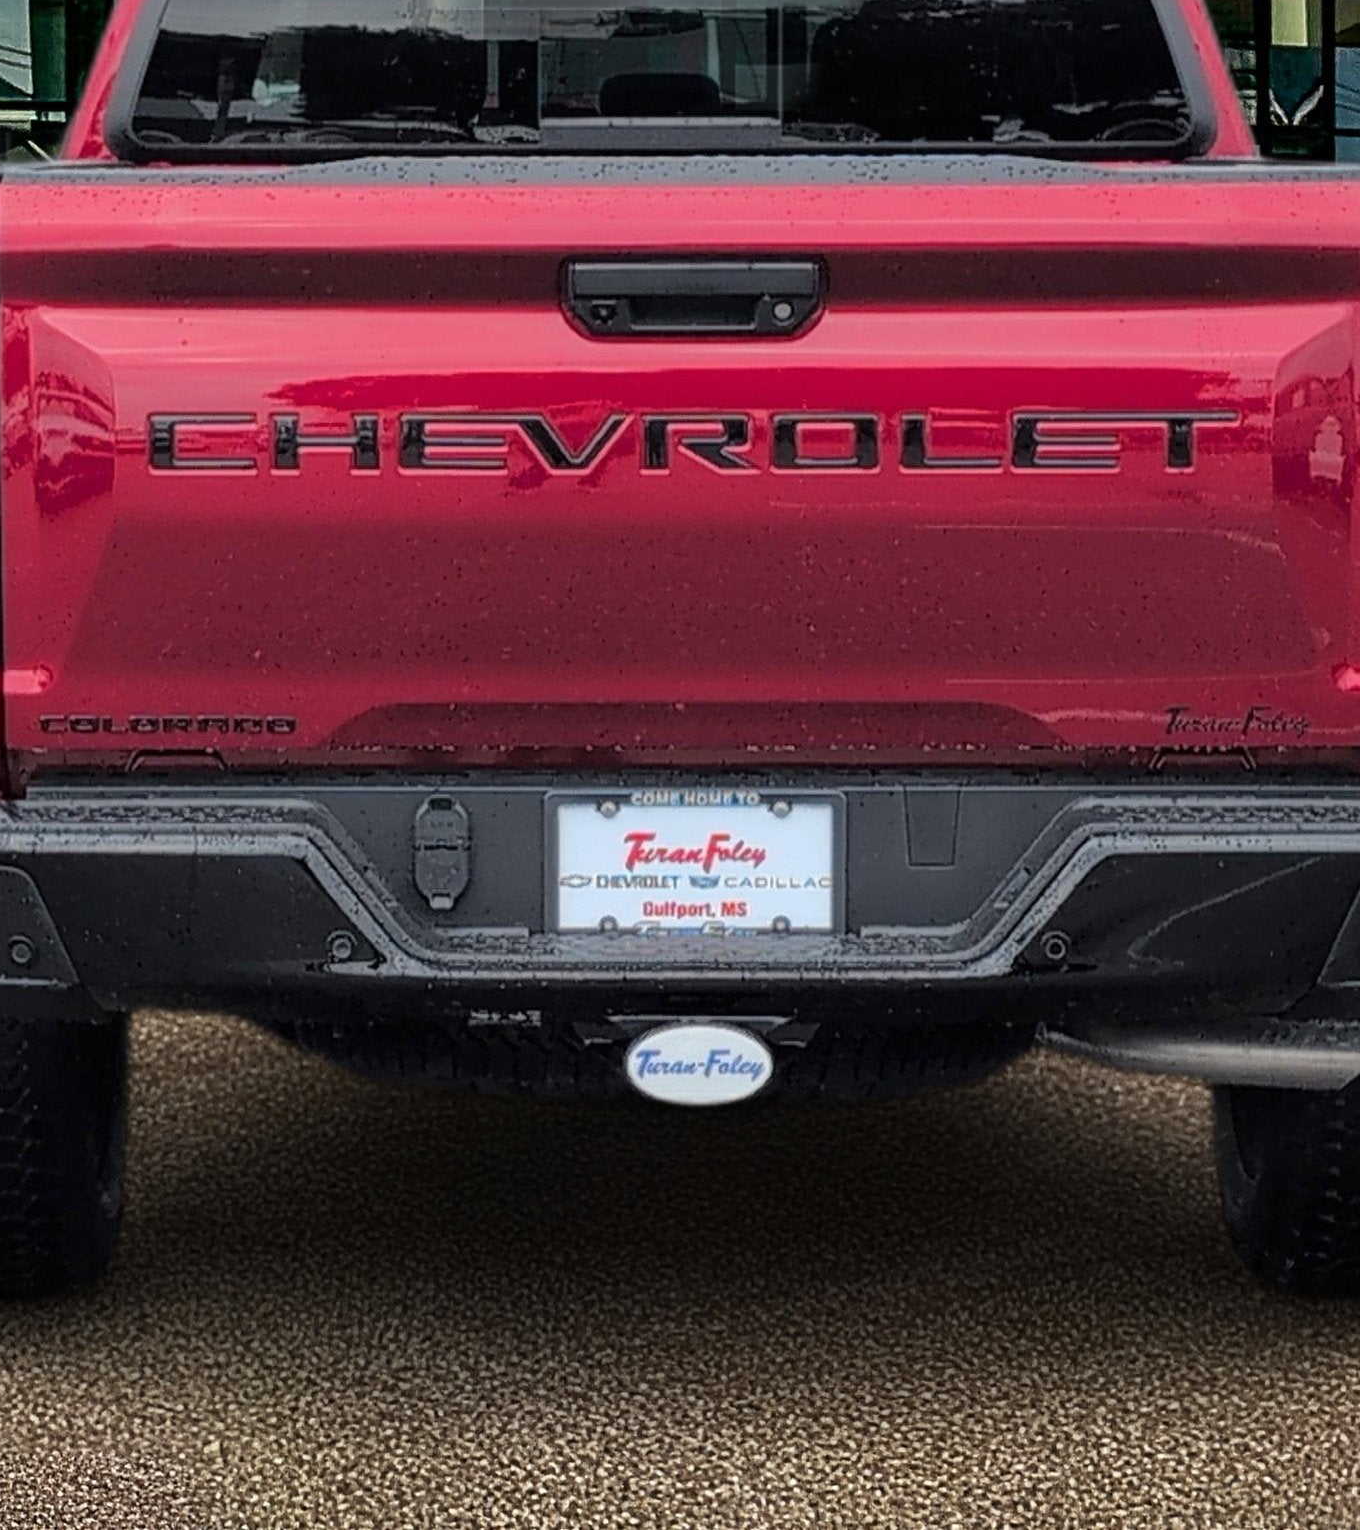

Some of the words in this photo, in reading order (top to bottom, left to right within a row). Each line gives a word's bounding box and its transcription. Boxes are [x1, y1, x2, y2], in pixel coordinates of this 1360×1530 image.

[145, 411, 1239, 475] CHEVROLET
[40, 713, 296, 735] COLORADO
[630, 789, 680, 805] COME
[683, 789, 732, 805] HOME
[736, 789, 761, 805] TO
[596, 875, 679, 889] CHEVROLET
[724, 876, 833, 889] CADILLAC
[642, 901, 715, 919] Gulfport,
[721, 901, 747, 917] MS
